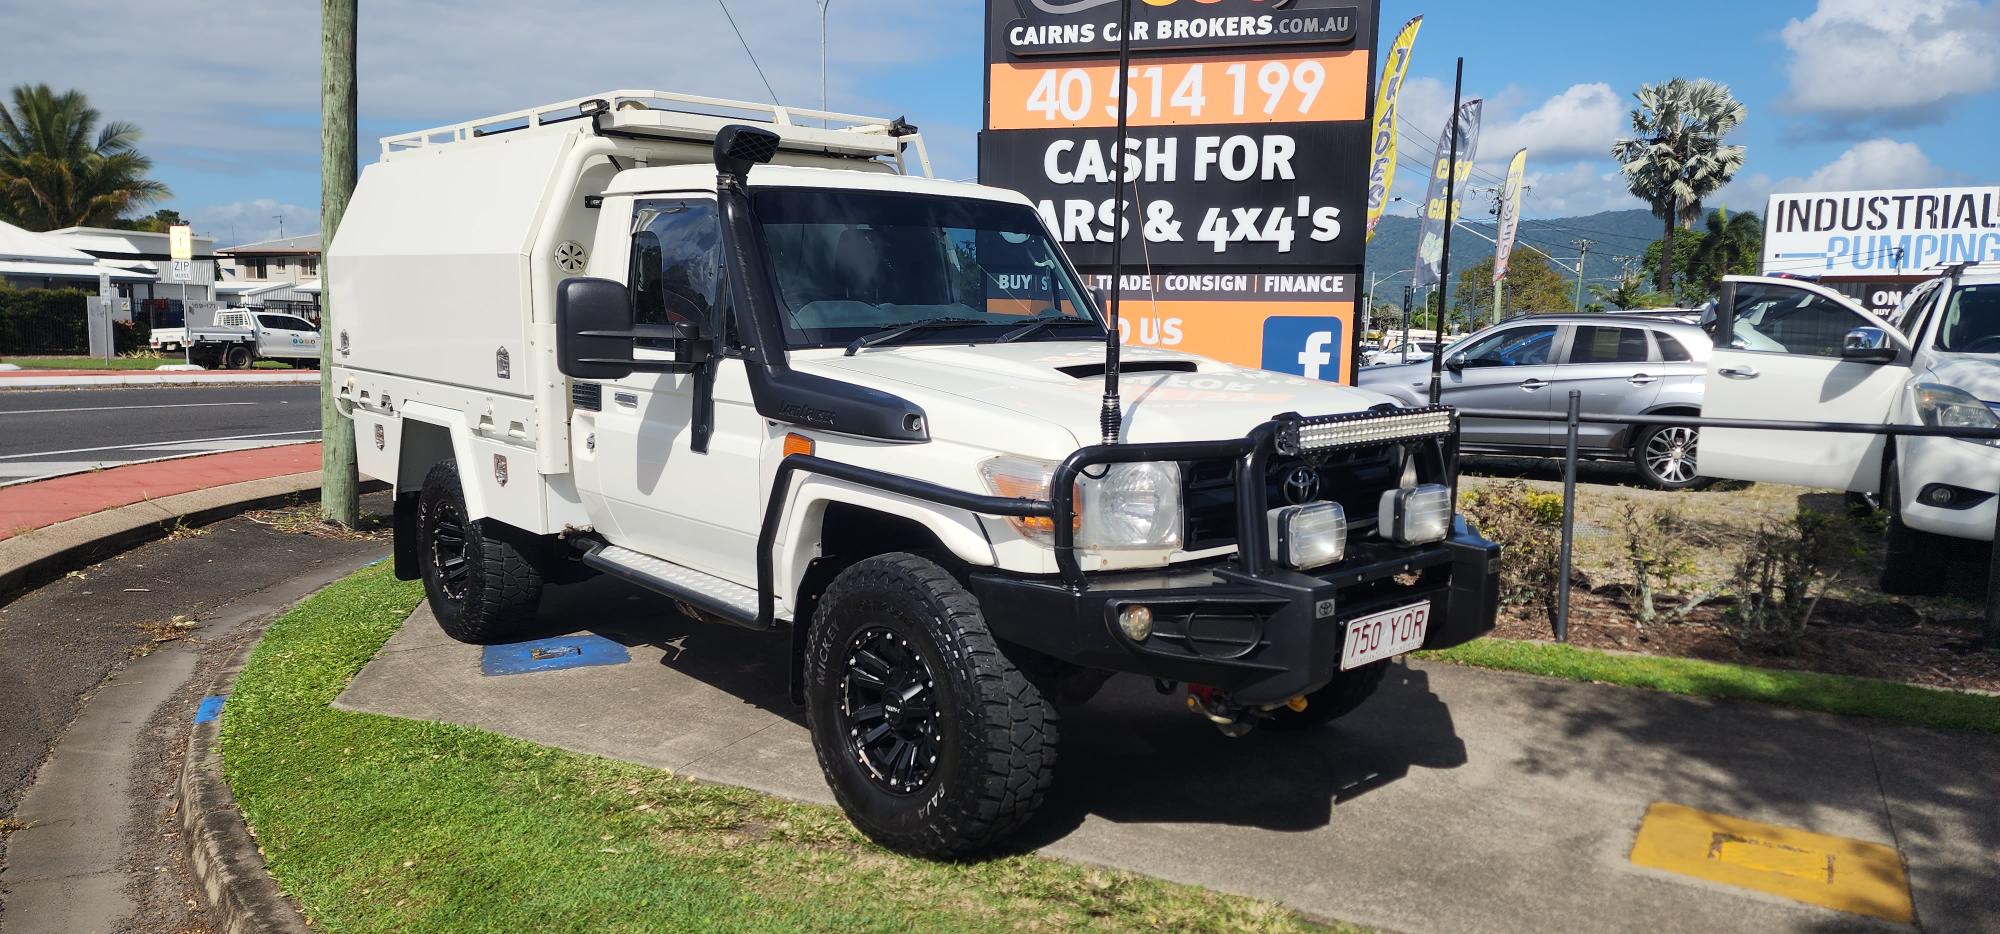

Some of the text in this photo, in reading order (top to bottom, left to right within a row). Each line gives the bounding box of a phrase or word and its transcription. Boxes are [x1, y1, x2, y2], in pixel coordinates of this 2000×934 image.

[1010, 23, 1095, 46] CAIRNS
[1026, 60, 1326, 121] 40 514 199
[1044, 134, 1296, 184] CASH FOR
[1037, 198, 1130, 243] ARS
[1144, 199, 1184, 242] &
[1427, 198, 1461, 222] CAS
[1776, 193, 1996, 233] INDUSTRIAL
[174, 261, 190, 271] ZIP
[1826, 232, 2000, 271] PUMPING
[999, 274, 1033, 290] BUY
[1164, 275, 1247, 292] CONSIGN
[1264, 275, 1344, 293] FINANCE
[1872, 290, 1902, 306] ON
[1140, 318, 1184, 345] US
[1351, 620, 1383, 658] 750
[1390, 610, 1425, 646] YOR
